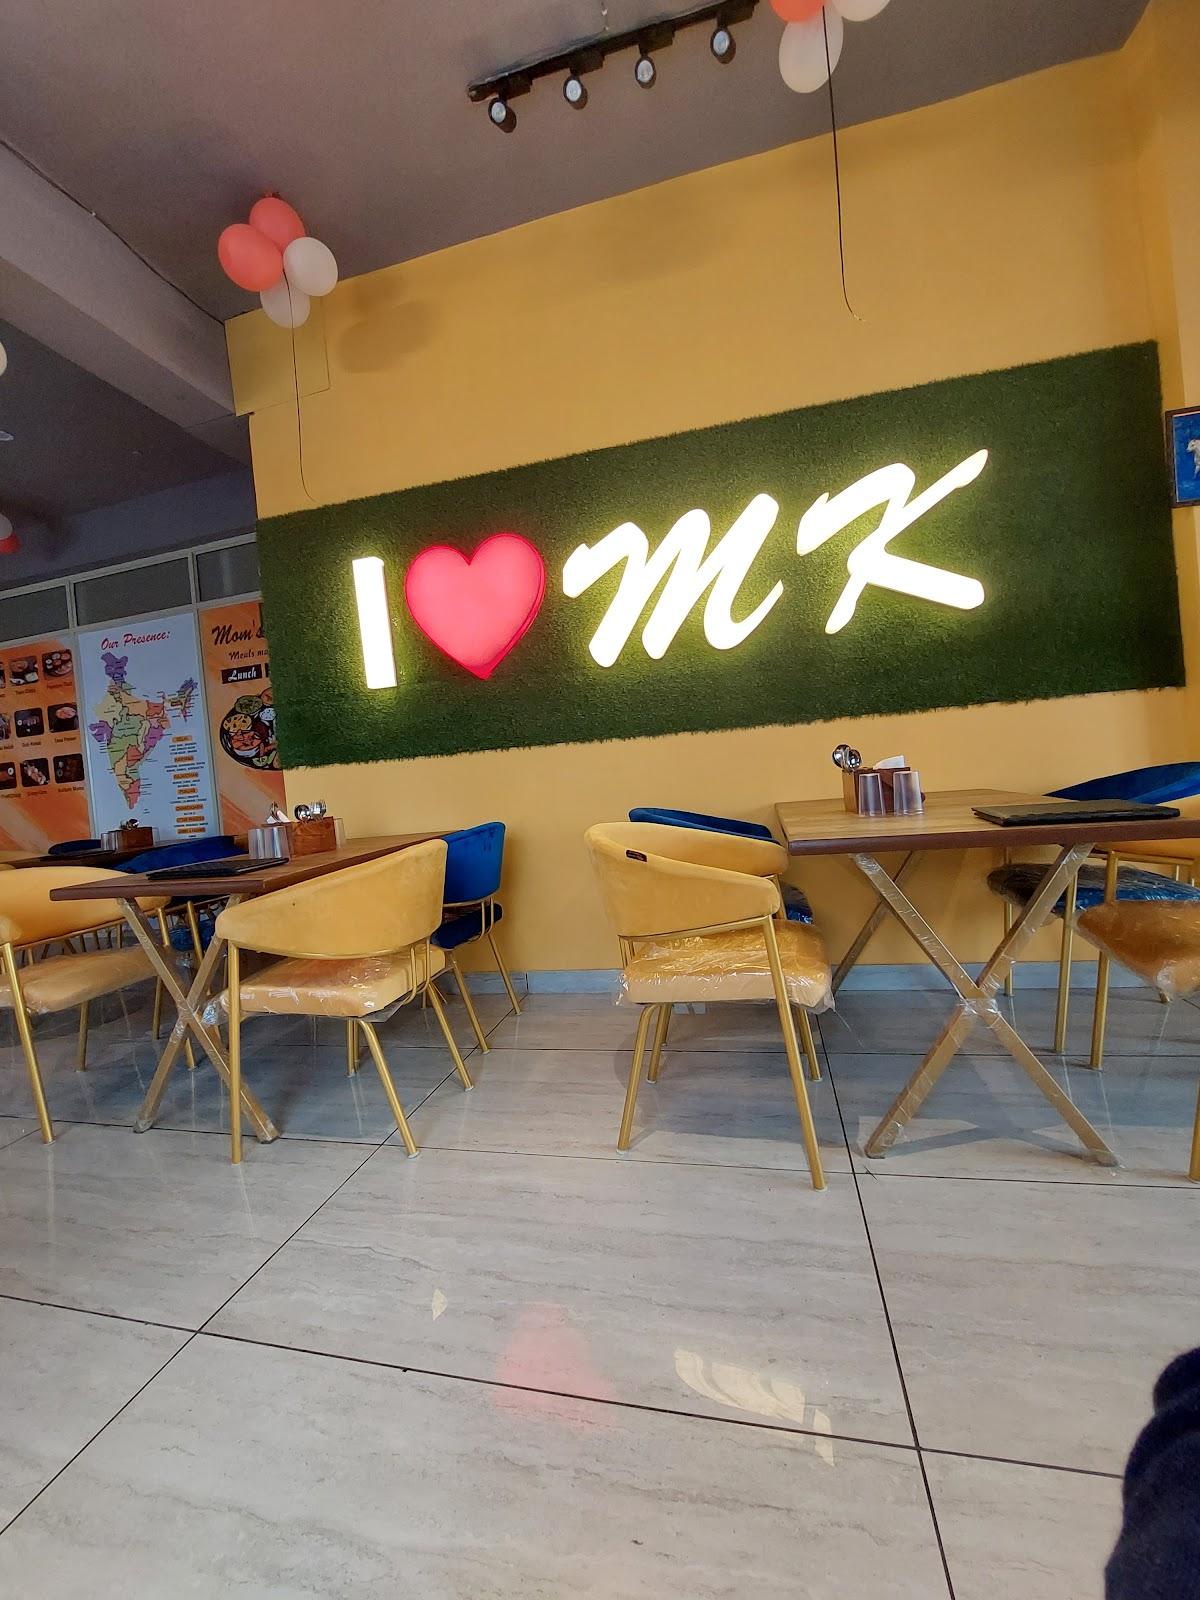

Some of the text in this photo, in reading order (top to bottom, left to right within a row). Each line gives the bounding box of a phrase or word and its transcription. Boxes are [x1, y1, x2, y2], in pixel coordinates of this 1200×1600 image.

[211, 619, 265, 645] Mom's
[351, 556, 396, 690] I
[101, 631, 171, 651] Our Presence:
[228, 649, 255, 661] Meals
[227, 666, 258, 682] Lunch
